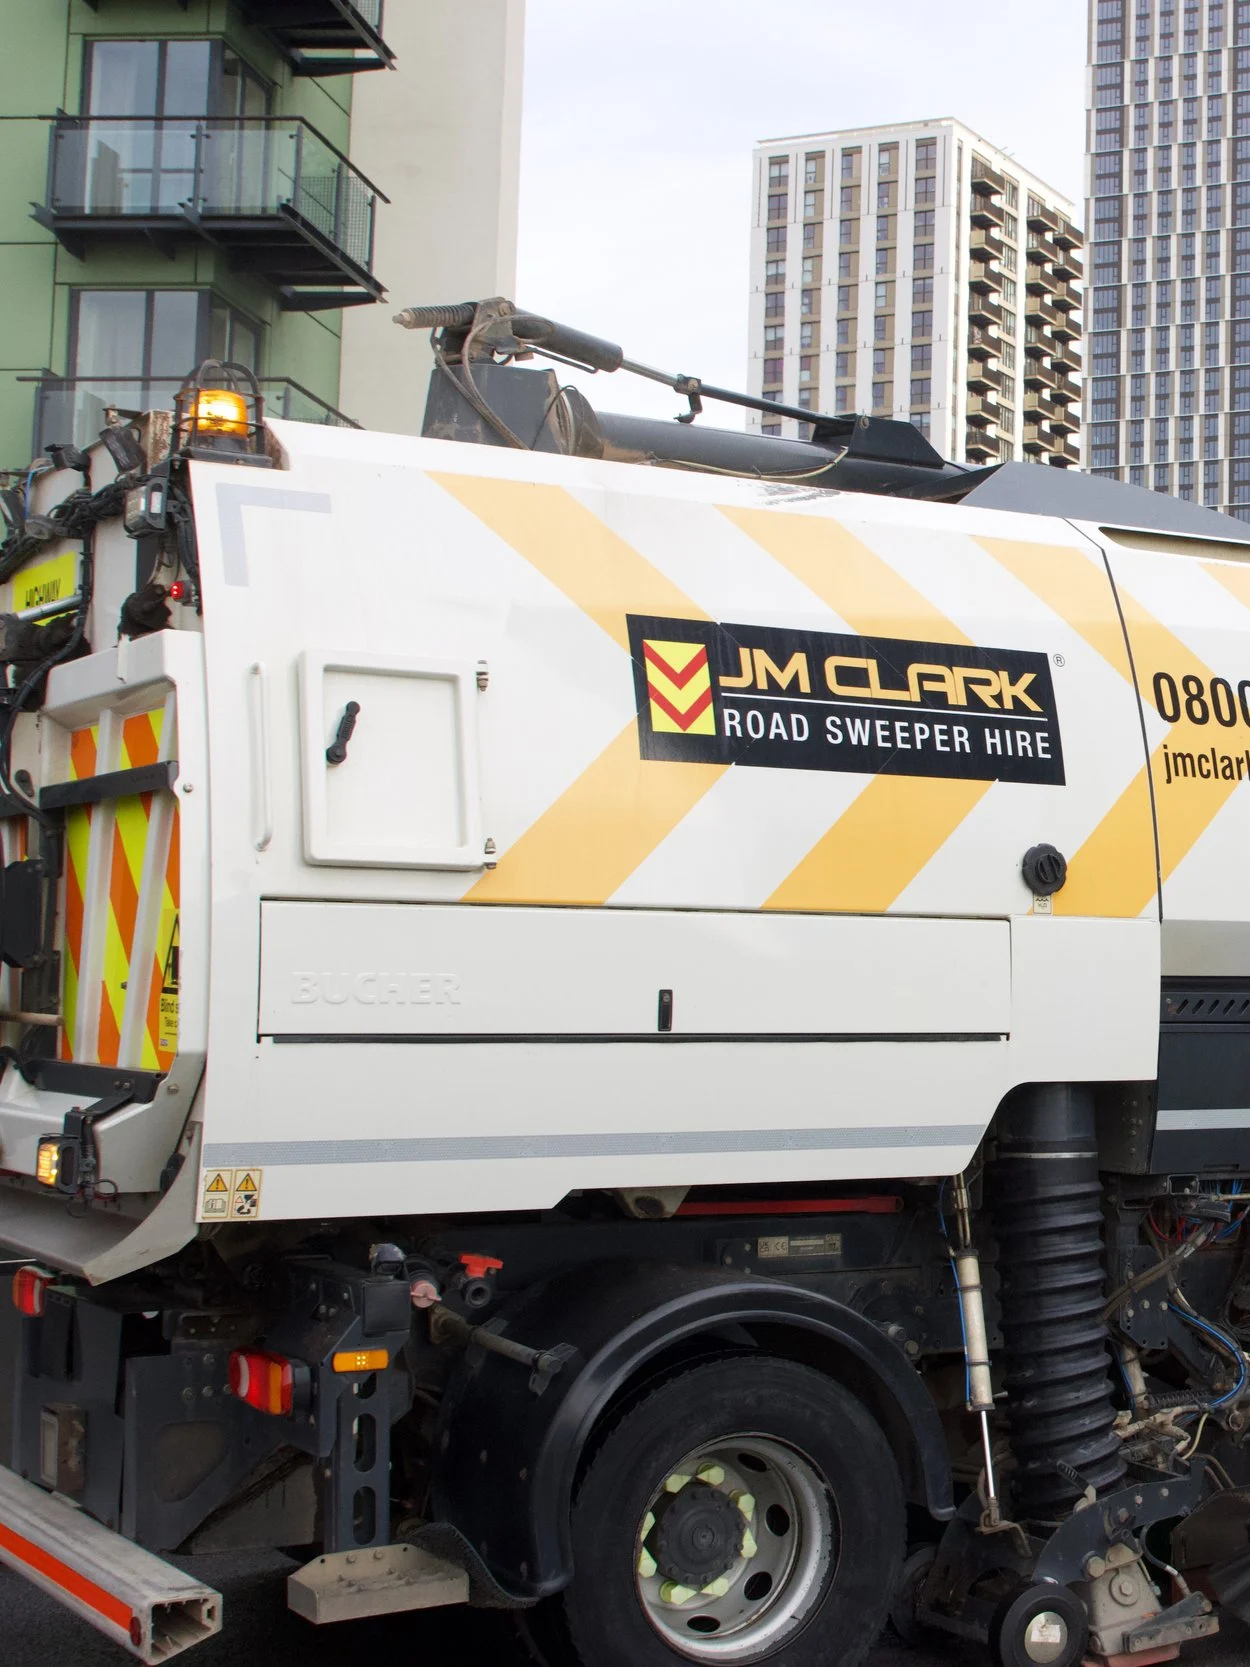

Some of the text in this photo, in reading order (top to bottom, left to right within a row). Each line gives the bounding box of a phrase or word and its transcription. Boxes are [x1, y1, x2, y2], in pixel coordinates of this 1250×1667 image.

[719, 647, 1044, 713] JM CLARK
[723, 708, 1052, 759] ROAD SWEEPER HIRE
[160, 998, 174, 1013] Blind
[291, 970, 462, 1005] BUCHER
